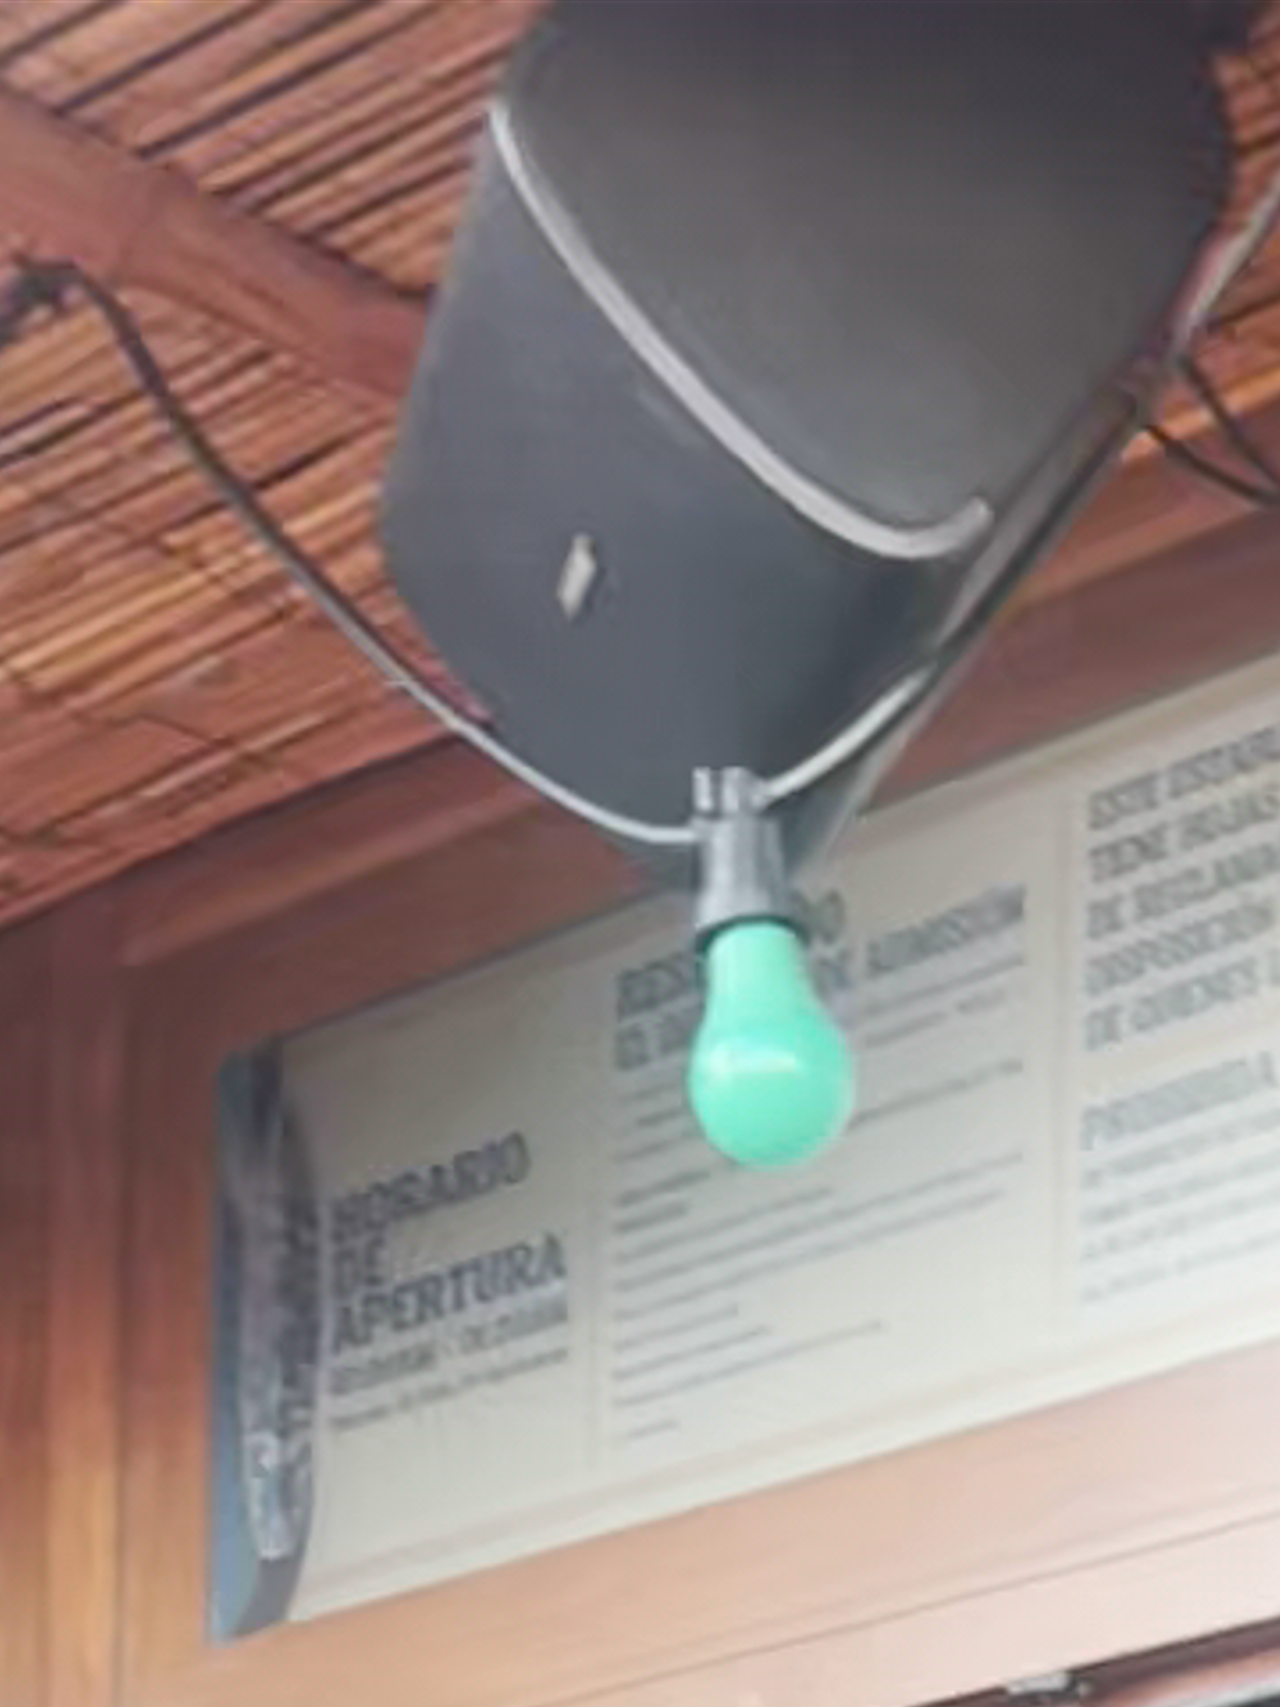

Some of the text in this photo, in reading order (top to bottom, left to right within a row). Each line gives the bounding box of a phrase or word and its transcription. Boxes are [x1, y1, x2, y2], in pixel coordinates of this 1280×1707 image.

[331, 1131, 532, 1244] HORARIO
[333, 1234, 389, 1294] DE
[334, 1230, 570, 1354] APERTURA
